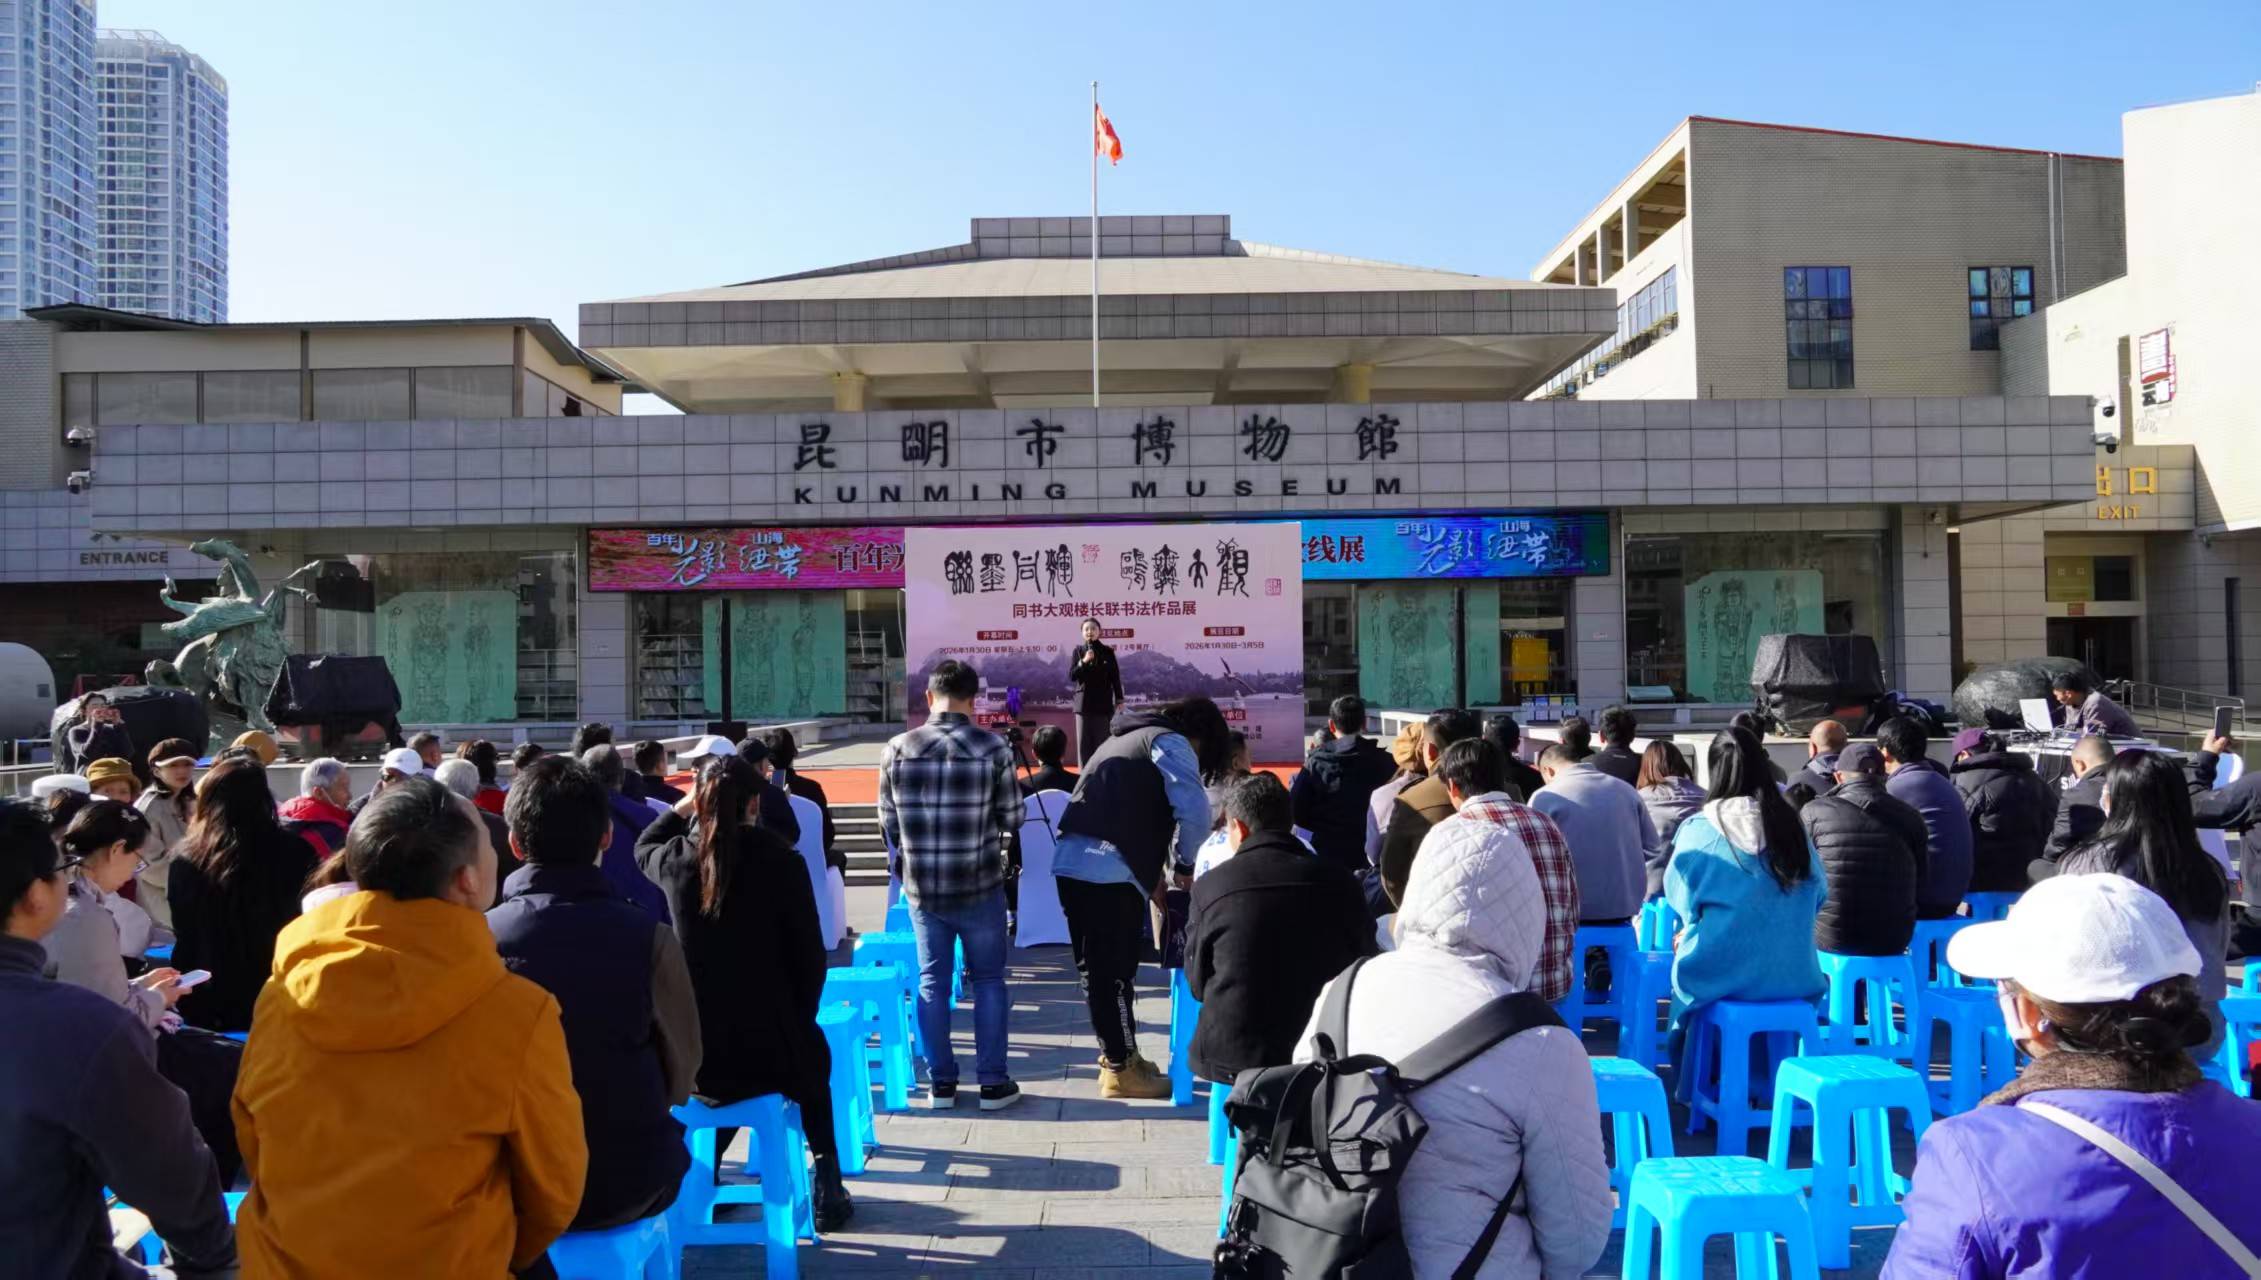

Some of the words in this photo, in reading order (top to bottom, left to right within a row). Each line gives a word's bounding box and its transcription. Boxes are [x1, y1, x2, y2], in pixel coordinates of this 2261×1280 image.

[794, 484, 1066, 504] KUNMING
[1131, 479, 1400, 498] MUSEUM
[2097, 504, 2142, 520] EXIT
[1302, 535, 1364, 563] 线展
[80, 551, 168, 565] ENTRANCE
[1012, 601, 1197, 618] 同书大观楼长联书法作品展
